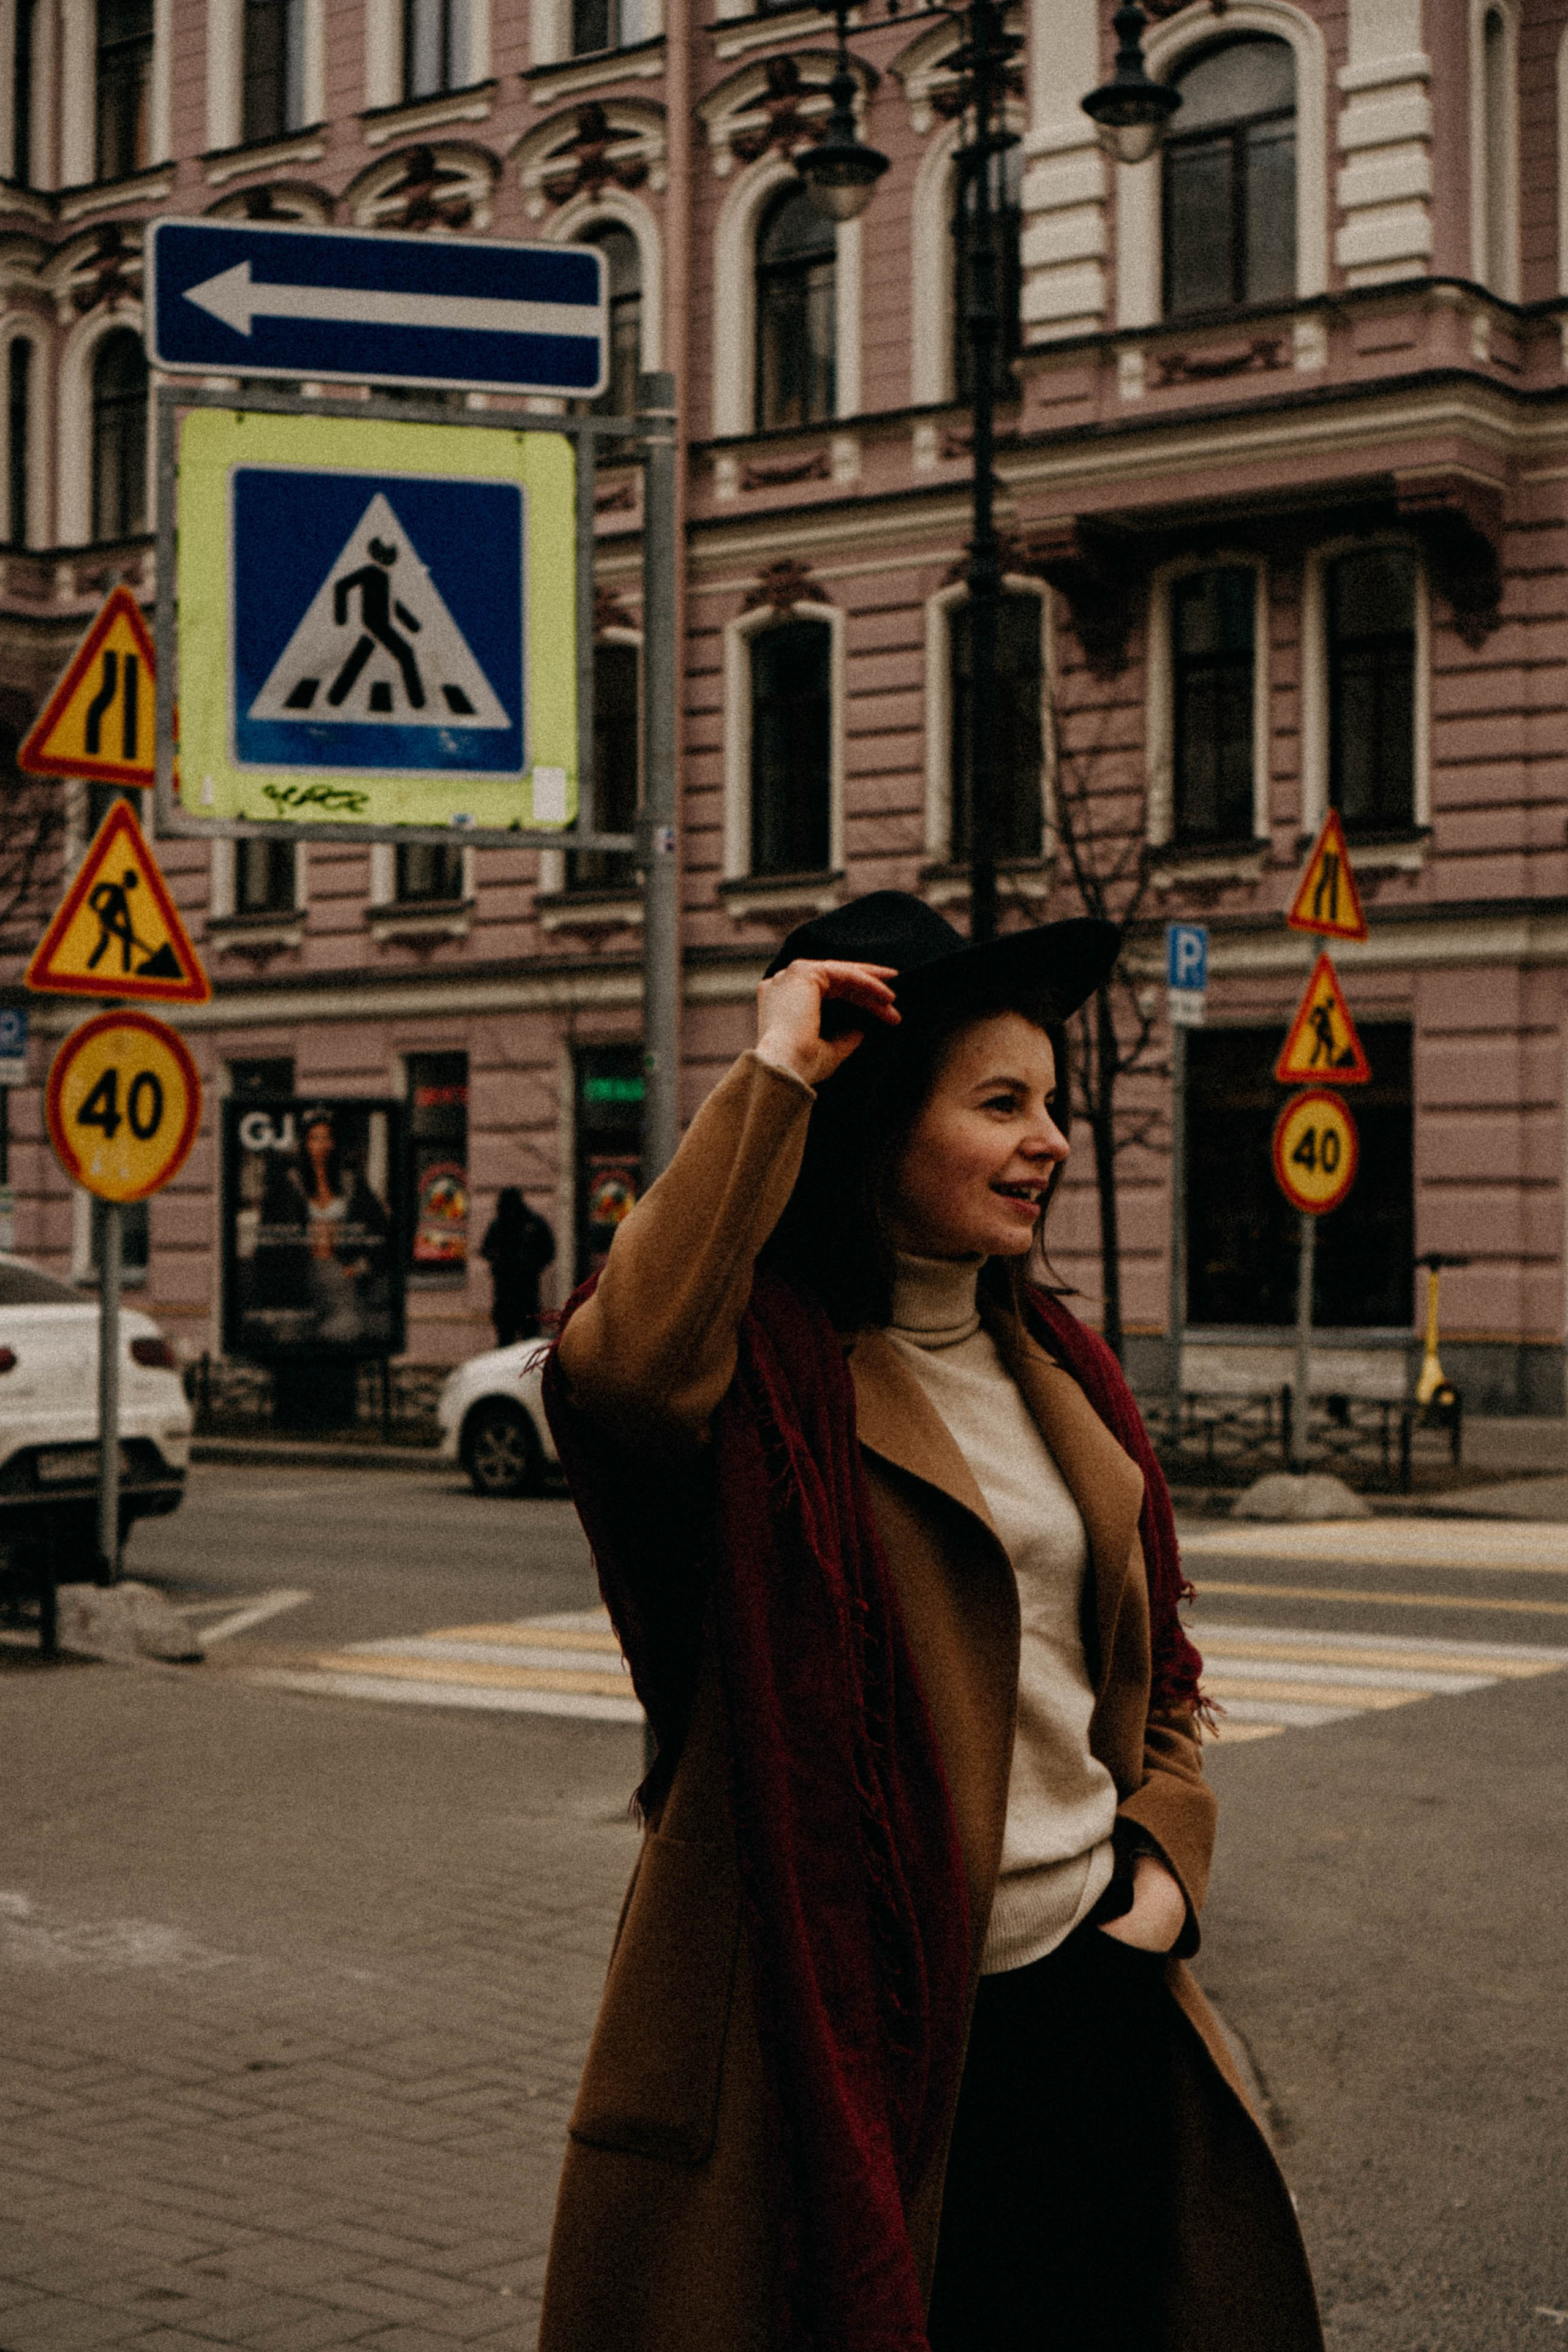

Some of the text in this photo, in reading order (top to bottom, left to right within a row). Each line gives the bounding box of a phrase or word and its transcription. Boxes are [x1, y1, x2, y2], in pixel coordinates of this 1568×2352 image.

[1177, 932, 1203, 981] P
[77, 1068, 163, 1140] 40
[1292, 1126, 1340, 1174] 40
